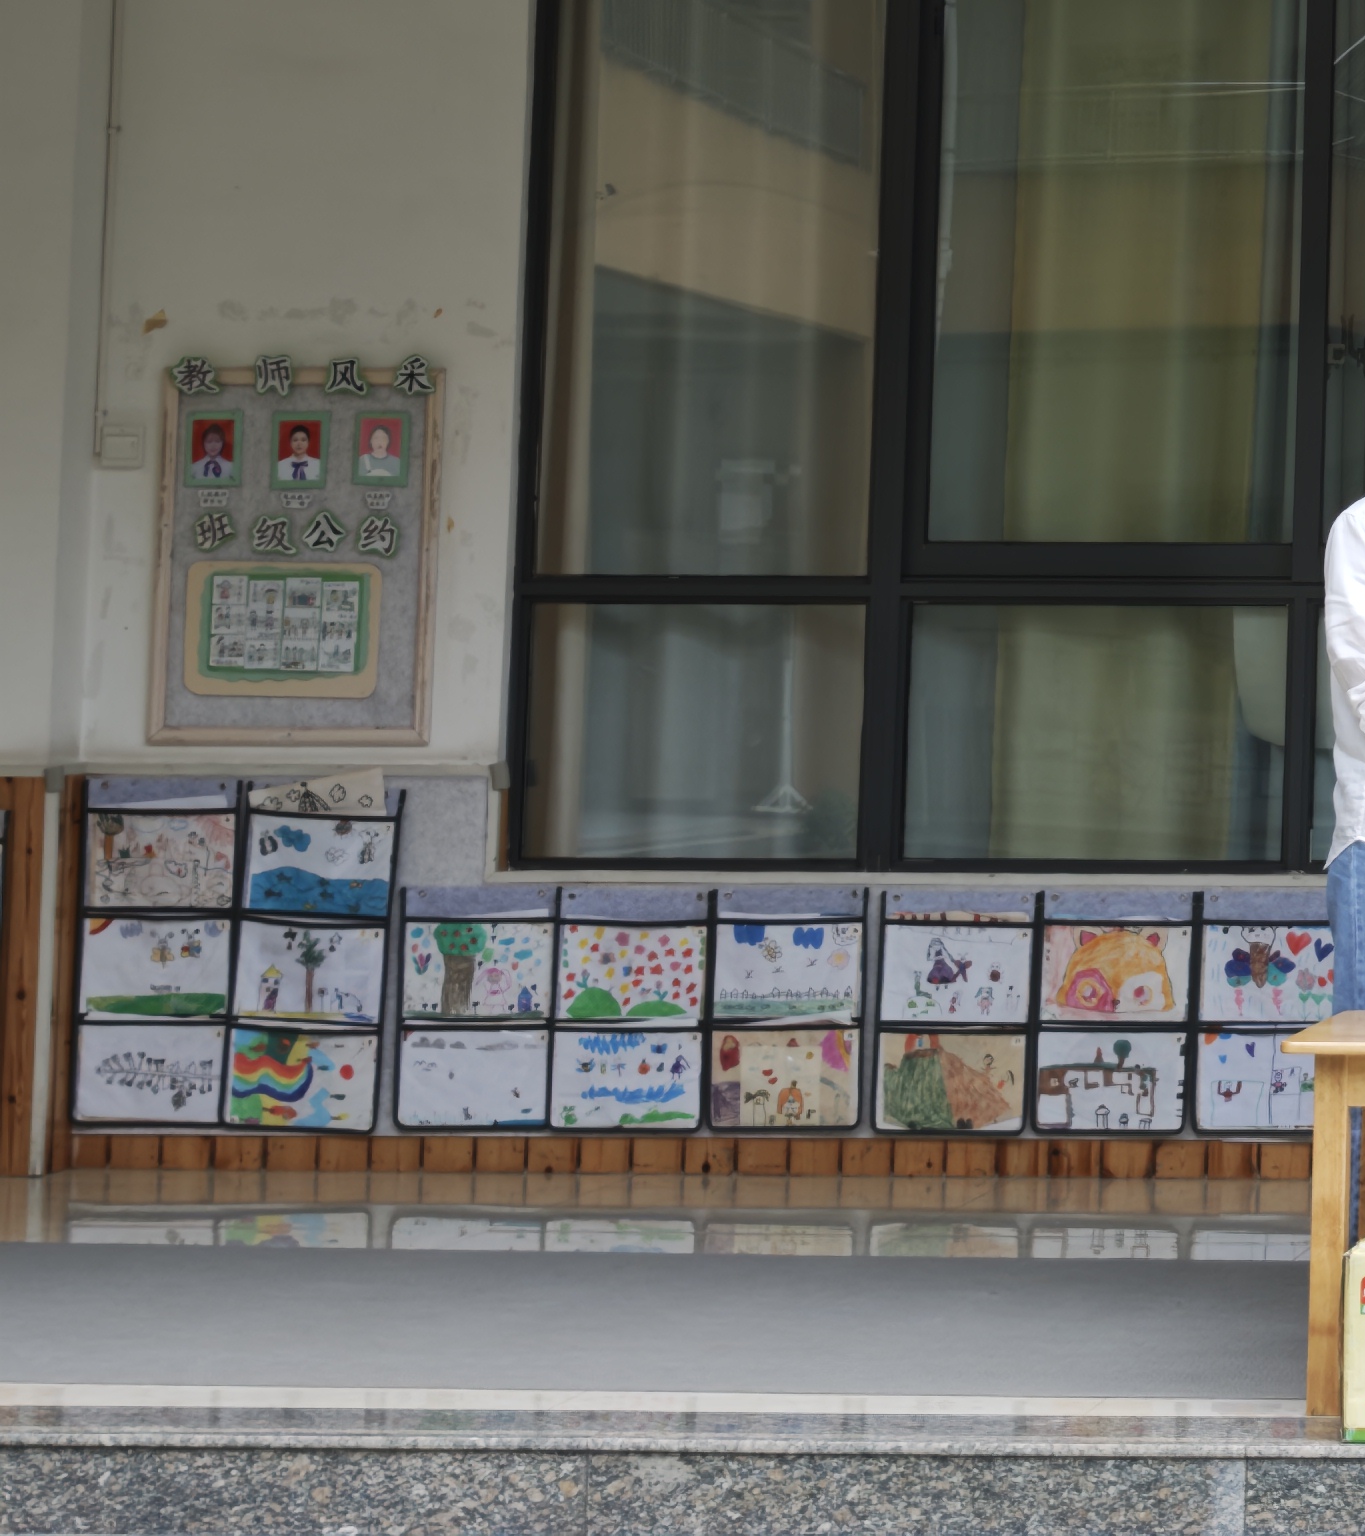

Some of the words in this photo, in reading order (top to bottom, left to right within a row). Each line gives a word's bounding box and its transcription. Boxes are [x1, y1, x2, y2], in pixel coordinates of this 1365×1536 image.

[175, 357, 435, 394] 教师风采
[196, 514, 398, 554] 班级公约
